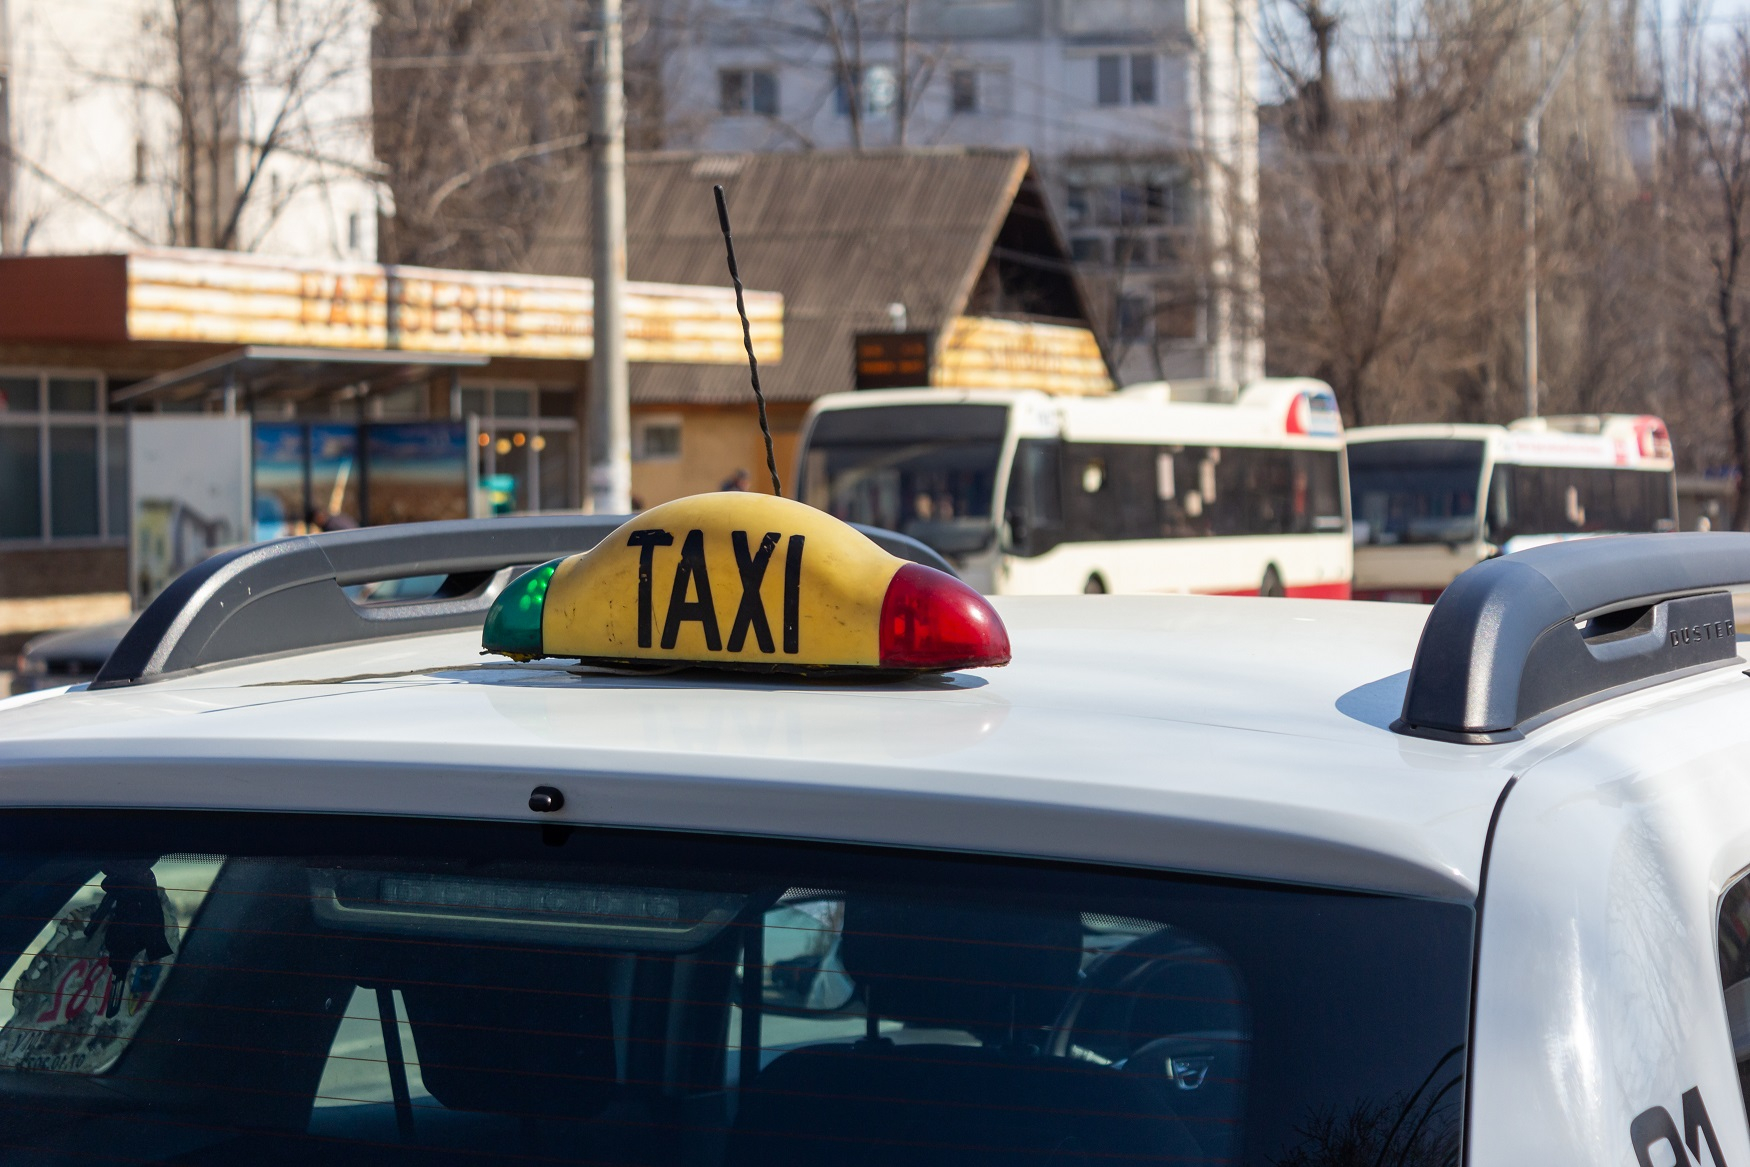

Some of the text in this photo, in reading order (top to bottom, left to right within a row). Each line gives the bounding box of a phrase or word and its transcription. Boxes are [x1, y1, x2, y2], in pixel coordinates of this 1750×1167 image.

[302, 274, 522, 338] PATSERIE
[626, 528, 806, 655] TAXI
[1669, 619, 1736, 647] DUSTER
